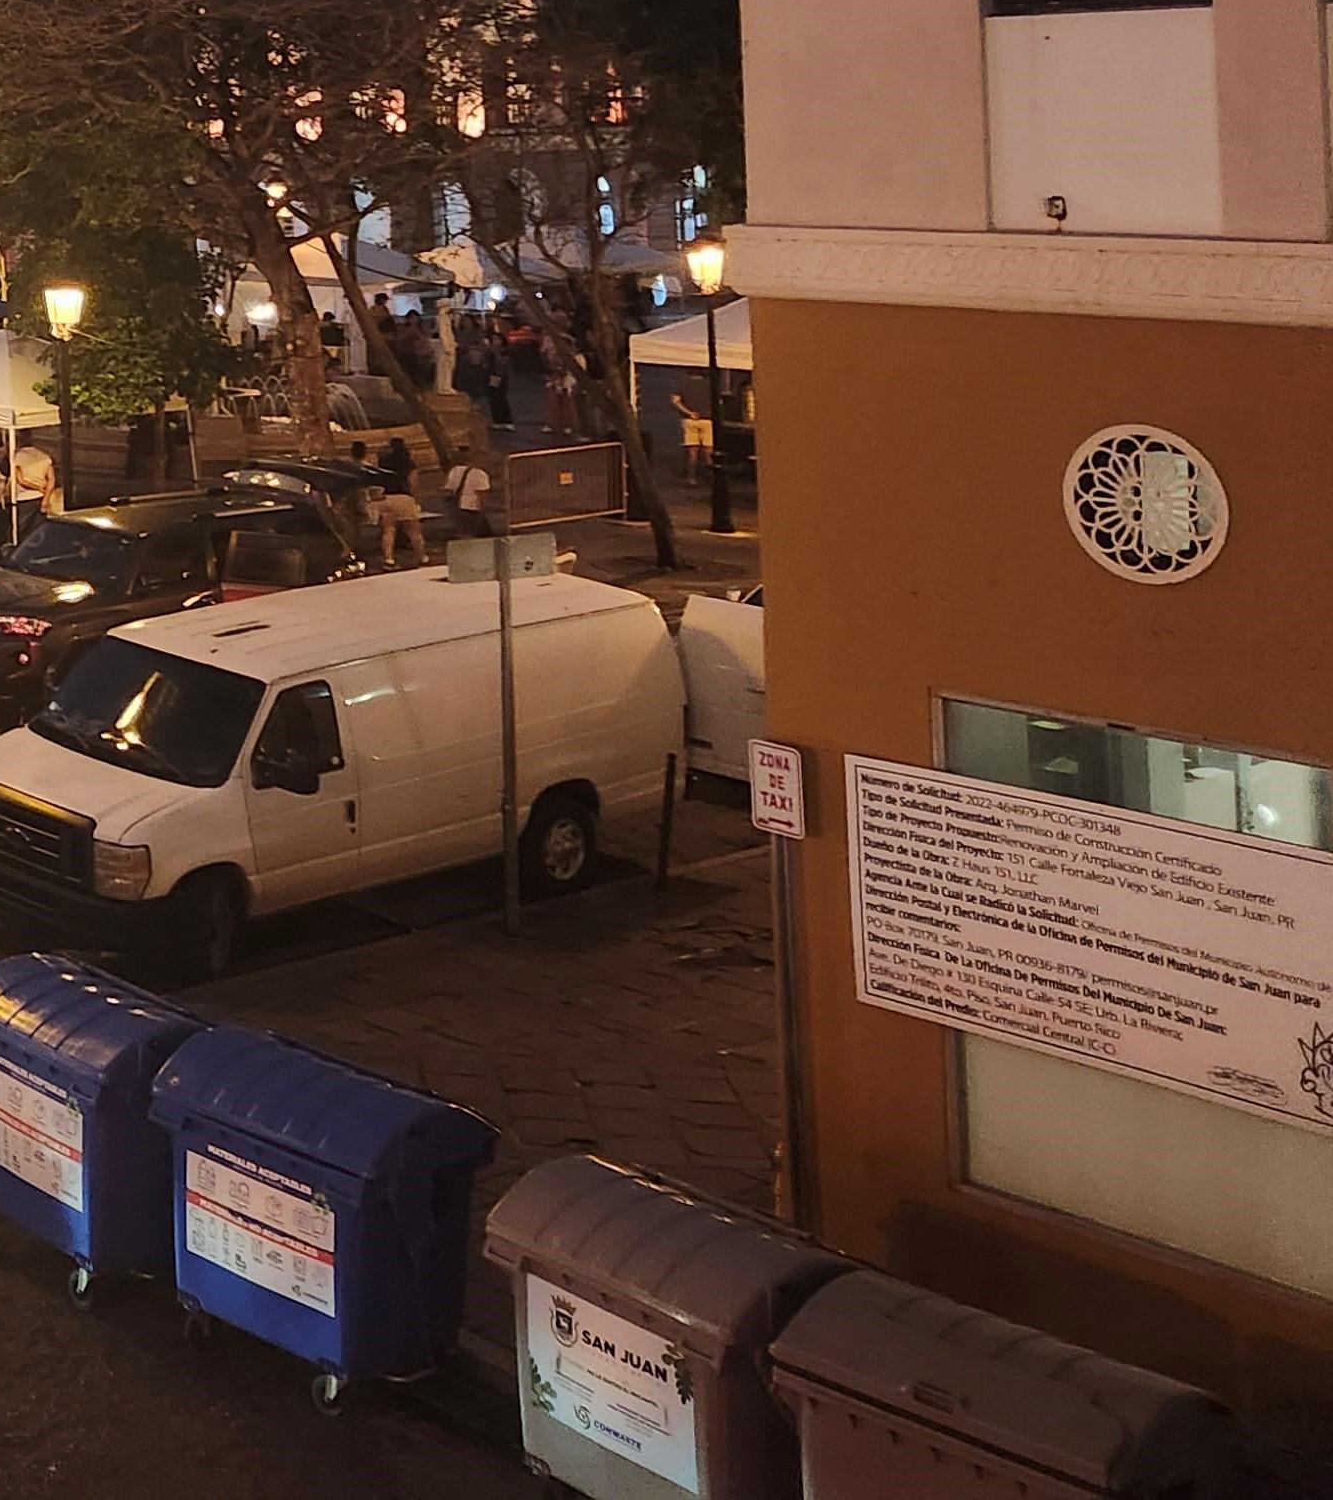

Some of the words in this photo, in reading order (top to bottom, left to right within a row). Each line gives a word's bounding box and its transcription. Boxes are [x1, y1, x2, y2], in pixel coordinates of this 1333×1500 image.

[758, 751, 790, 772] ZONA
[769, 774, 785, 790] DE
[902, 782, 914, 793] de
[760, 791, 793, 812] TAXI
[861, 788, 882, 803] Tipo
[885, 794, 897, 805] de
[899, 796, 942, 815] Solicitud
[1006, 818, 1053, 838] Permiso
[1056, 829, 1071, 842] de
[1155, 850, 1221, 876] Certificado
[862, 804, 883, 819] Tipo
[885, 810, 897, 821] de
[900, 812, 942, 833] Proyecto
[1070, 850, 1078, 862] y
[1151, 867, 1167, 880] de
[1170, 871, 1214, 893] Edificio
[1218, 882, 1275, 907] Existente
[863, 851, 917, 876] Proyectista
[919, 864, 931, 877] de
[933, 867, 942, 879] la
[1001, 882, 1056, 906] Jonathan
[1058, 895, 1099, 916] Marvel
[896, 843, 908, 856] de
[911, 847, 919, 858] la
[962, 858, 990, 875] Haus
[1018, 870, 1039, 886] LLC
[938, 837, 954, 849] del
[1007, 851, 1025, 865] 151
[1028, 856, 1058, 873] Calle
[1060, 863, 1114, 886] Fortaleza
[1117, 875, 1147, 895] Viejo
[1151, 883, 1173, 899] San
[1213, 898, 1237, 915] San
[1277, 914, 1294, 929] PR
[864, 867, 902, 888] Agencia
[905, 877, 927, 892] Ante
[930, 882, 938, 895] la
[941, 885, 963, 901] Cual
[964, 892, 977, 904] se
[1017, 903, 1026, 915] la
[1028, 905, 1079, 929] Solicitud:
[1081, 919, 1116, 937] Oficina
[1119, 928, 1132, 941] de
[1181, 945, 1197, 958] del
[865, 899, 895, 917] recibir
[866, 914, 882, 929] PO
[942, 934, 963, 950] San
[997, 947, 1013, 961] PR
[911, 895, 941, 912] Postal
[943, 904, 950, 916] y
[1011, 918, 1024, 932] de
[1027, 922, 1036, 934] la
[1038, 924, 1077, 944] Oficina
[1079, 934, 1093, 948] de
[1095, 937, 1145, 961] Permisos
[1147, 951, 1163, 966] del
[1166, 956, 1219, 983] Municipio
[1222, 971, 1235, 986] de
[1238, 976, 1260, 992] San
[1263, 982, 1290, 1000] Juan
[1293, 991, 1320, 1010] para
[892, 952, 908, 967] De
[910, 957, 944, 978] Diego
[957, 969, 975, 985] 130
[978, 974, 1022, 1000] Esquina
[1025, 987, 1054, 1005] Calle
[1058, 995, 1072, 1010] 54
[1123, 1013, 1136, 1027] La
[944, 950, 958, 964] De
[960, 954, 972, 968] La
[975, 957, 1011, 978] Oficina
[1014, 967, 1028, 982] De
[1030, 971, 1080, 996] Permisos
[1082, 984, 1100, 1000] Del
[1103, 990, 1154, 1016] Municipio
[1157, 1005, 1171, 1020] De
[1174, 1009, 1194, 1027] San
[927, 994, 942, 1008] del
[982, 1007, 1039, 1035] Comercial
[1042, 1024, 1085, 1048] Central
[993, 995, 1016, 1012] San
[1052, 1011, 1091, 1033] Puerto
[1095, 1022, 1120, 1040] Rico
[582, 1330, 616, 1357] SAN
[620, 1351, 668, 1383] JUAN
